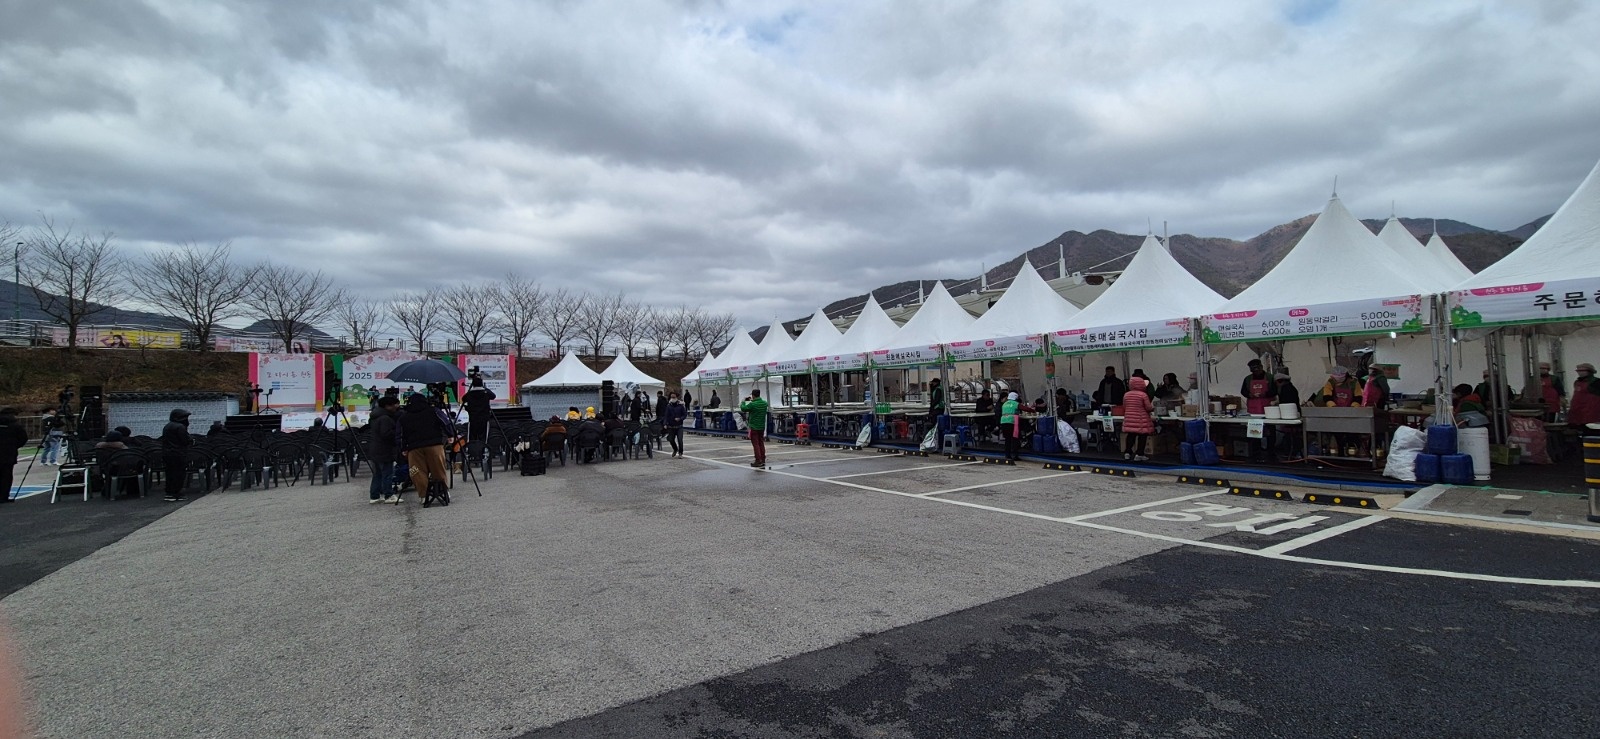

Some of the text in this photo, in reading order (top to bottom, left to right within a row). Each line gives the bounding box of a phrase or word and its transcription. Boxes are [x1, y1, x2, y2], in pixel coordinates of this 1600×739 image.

[1534, 290, 1600, 311] 주문
[1361, 311, 1397, 320] 5,000원
[1080, 328, 1148, 343] 원동매실국시집
